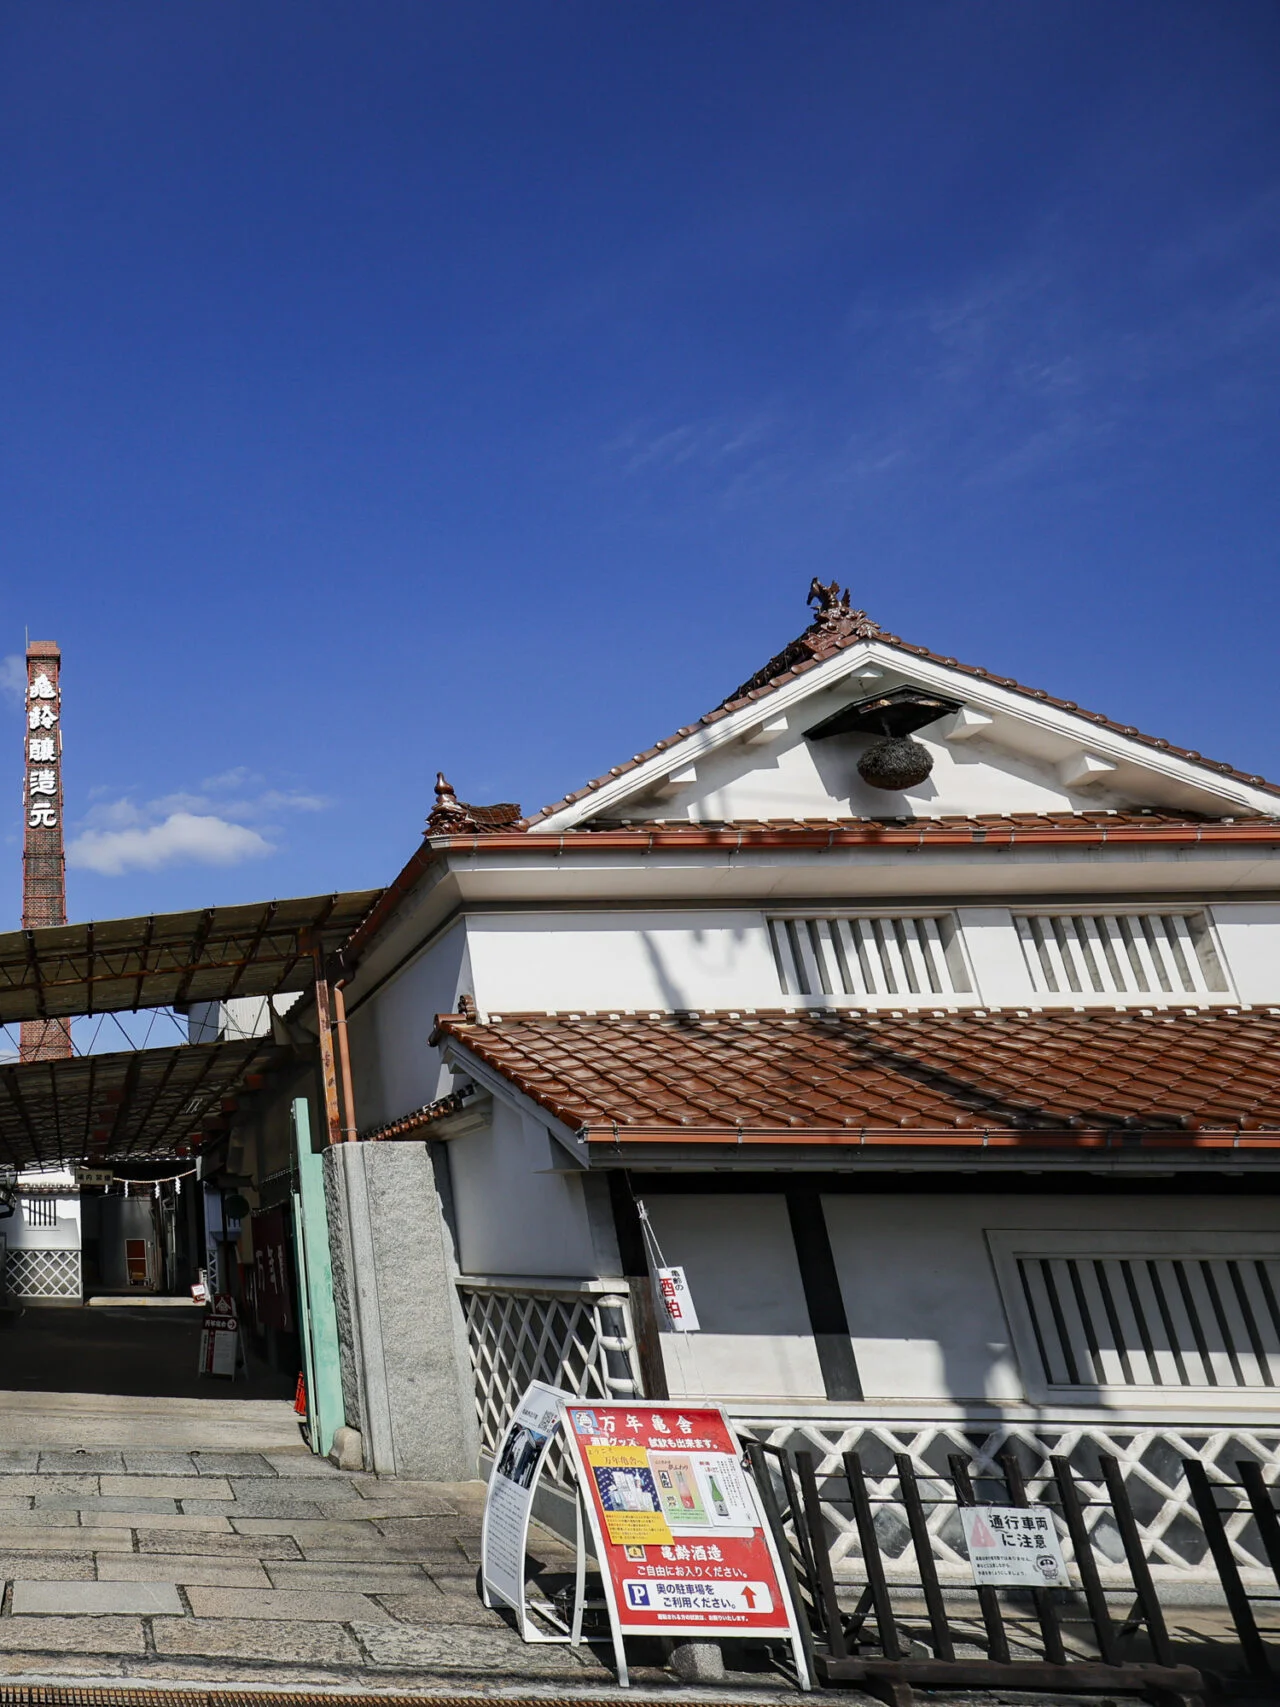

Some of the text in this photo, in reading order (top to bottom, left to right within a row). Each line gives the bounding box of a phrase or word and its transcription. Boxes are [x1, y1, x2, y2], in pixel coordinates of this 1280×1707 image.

[598, 1413, 694, 1435] 万年亀舎
[988, 1514, 1049, 1532] 通行車両
[1001, 1533, 1048, 1549] に注意
[661, 1543, 725, 1562] 亀齢酒造
[636, 1565, 748, 1579] ご自由にお入りください。
[656, 1583, 715, 1596] 奥の駐車場を
[663, 1596, 736, 1610] ご利用ください。
